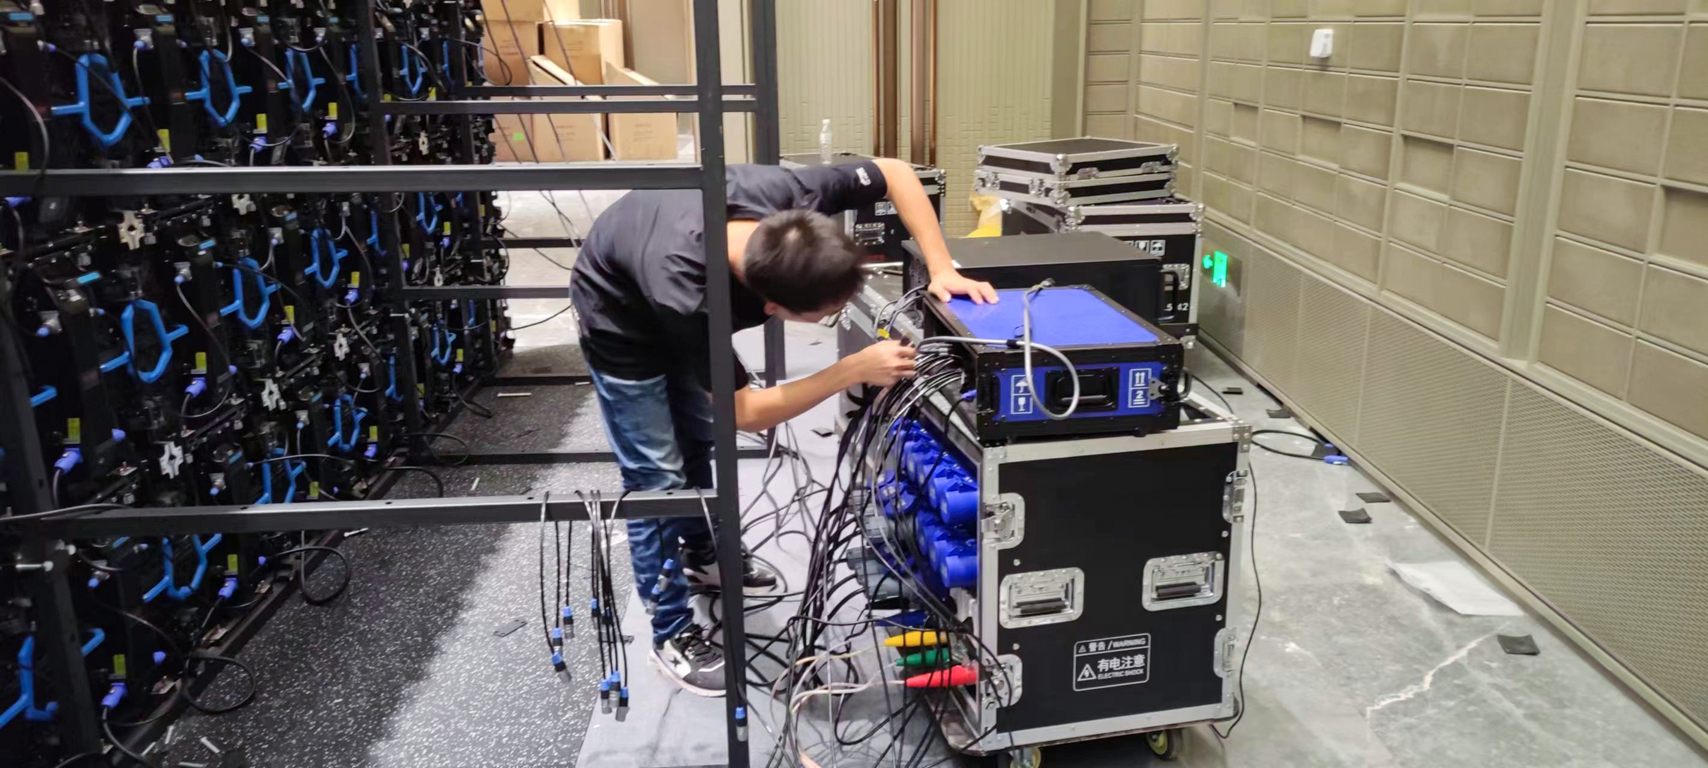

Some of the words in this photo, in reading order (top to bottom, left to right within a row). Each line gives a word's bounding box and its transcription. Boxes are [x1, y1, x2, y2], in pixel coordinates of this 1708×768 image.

[1136, 390, 1144, 399] 2
[1089, 641, 1106, 652] 警告
[1097, 654, 1146, 672] 有电注意
[1097, 670, 1124, 680] ELECTRIC
[1125, 668, 1144, 677] SHOCK
